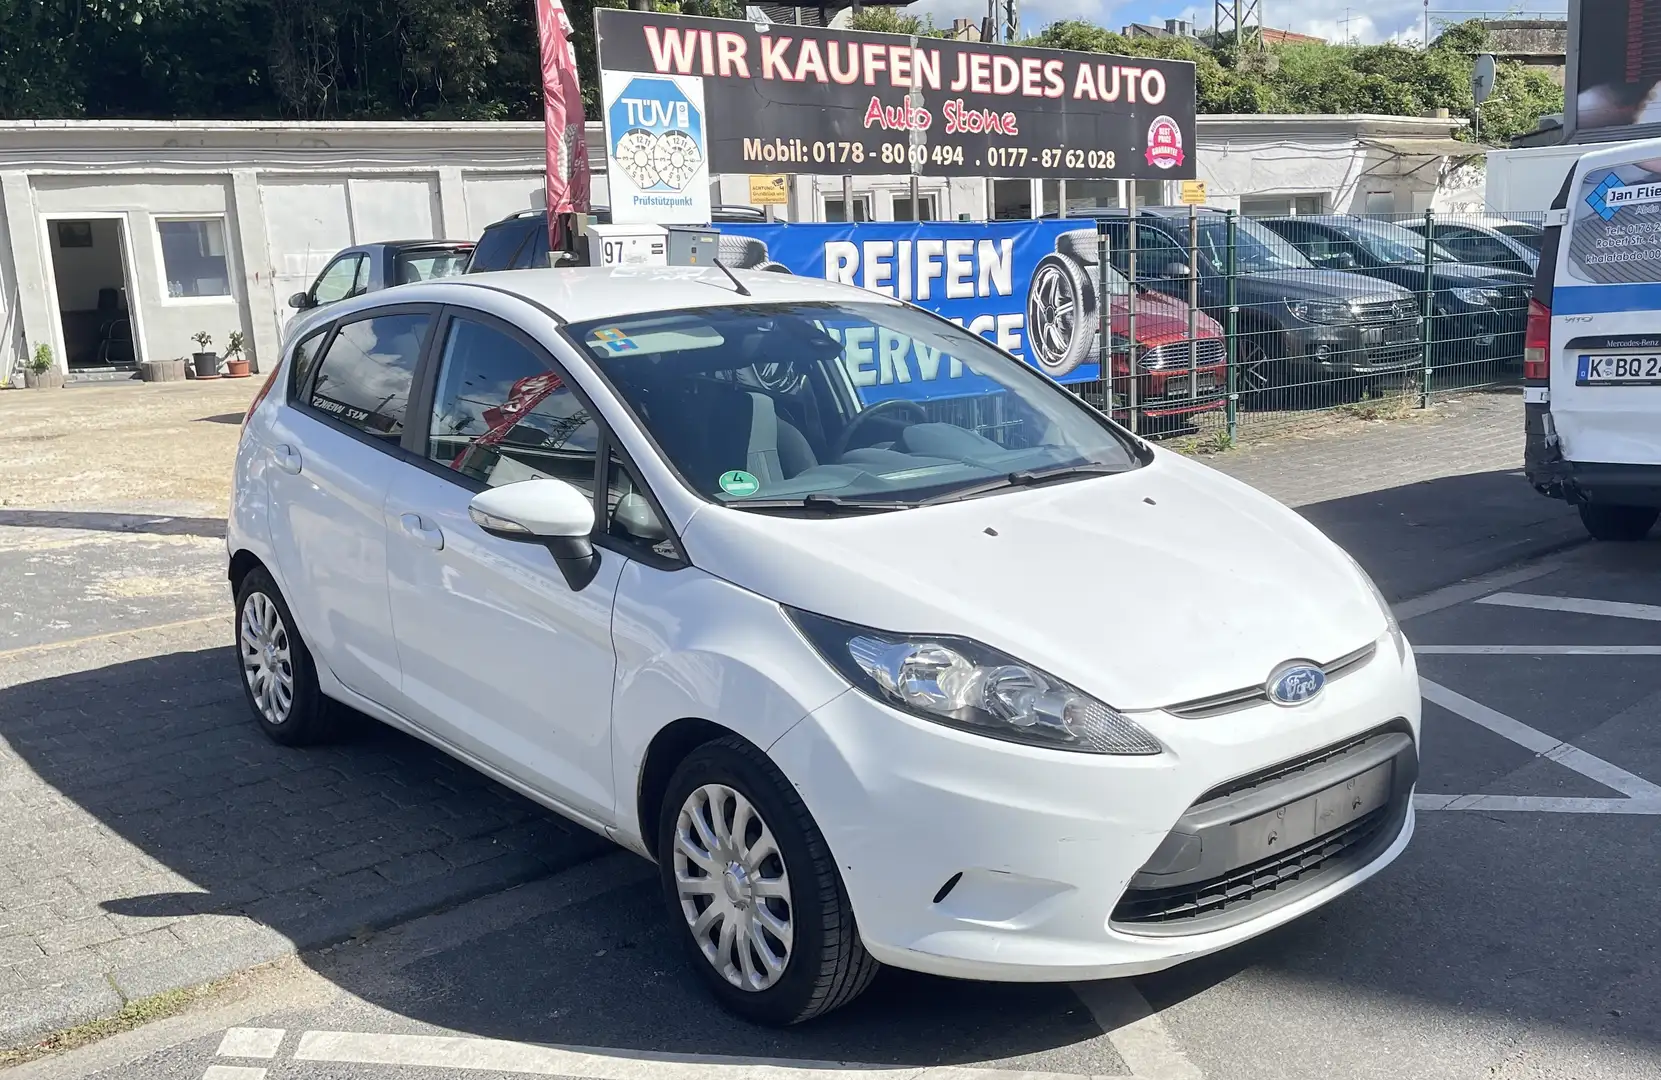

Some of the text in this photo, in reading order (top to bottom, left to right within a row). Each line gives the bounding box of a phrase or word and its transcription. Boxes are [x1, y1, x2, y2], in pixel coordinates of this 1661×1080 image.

[643, 25, 1167, 105] WIR KAUFEN JEDES AUTO
[621, 98, 675, 126] TÜV
[864, 95, 1019, 136] Auto Stone
[743, 138, 808, 163] Mobil:
[812, 141, 864, 164] 0178
[931, 145, 964, 166] 494
[987, 148, 1028, 168] 0177
[633, 195, 693, 208] Prüfstützpunkt
[1609, 191, 1633, 202] Jan
[604, 240, 623, 264] 97
[1595, 235, 1629, 249] Robert
[823, 238, 1015, 301] REIFEN
[825, 313, 1025, 388] ERVICE
[1606, 339, 1660, 348] Mercedes-Benz
[732, 472, 744, 483] 4
[1286, 670, 1317, 698] Ford
